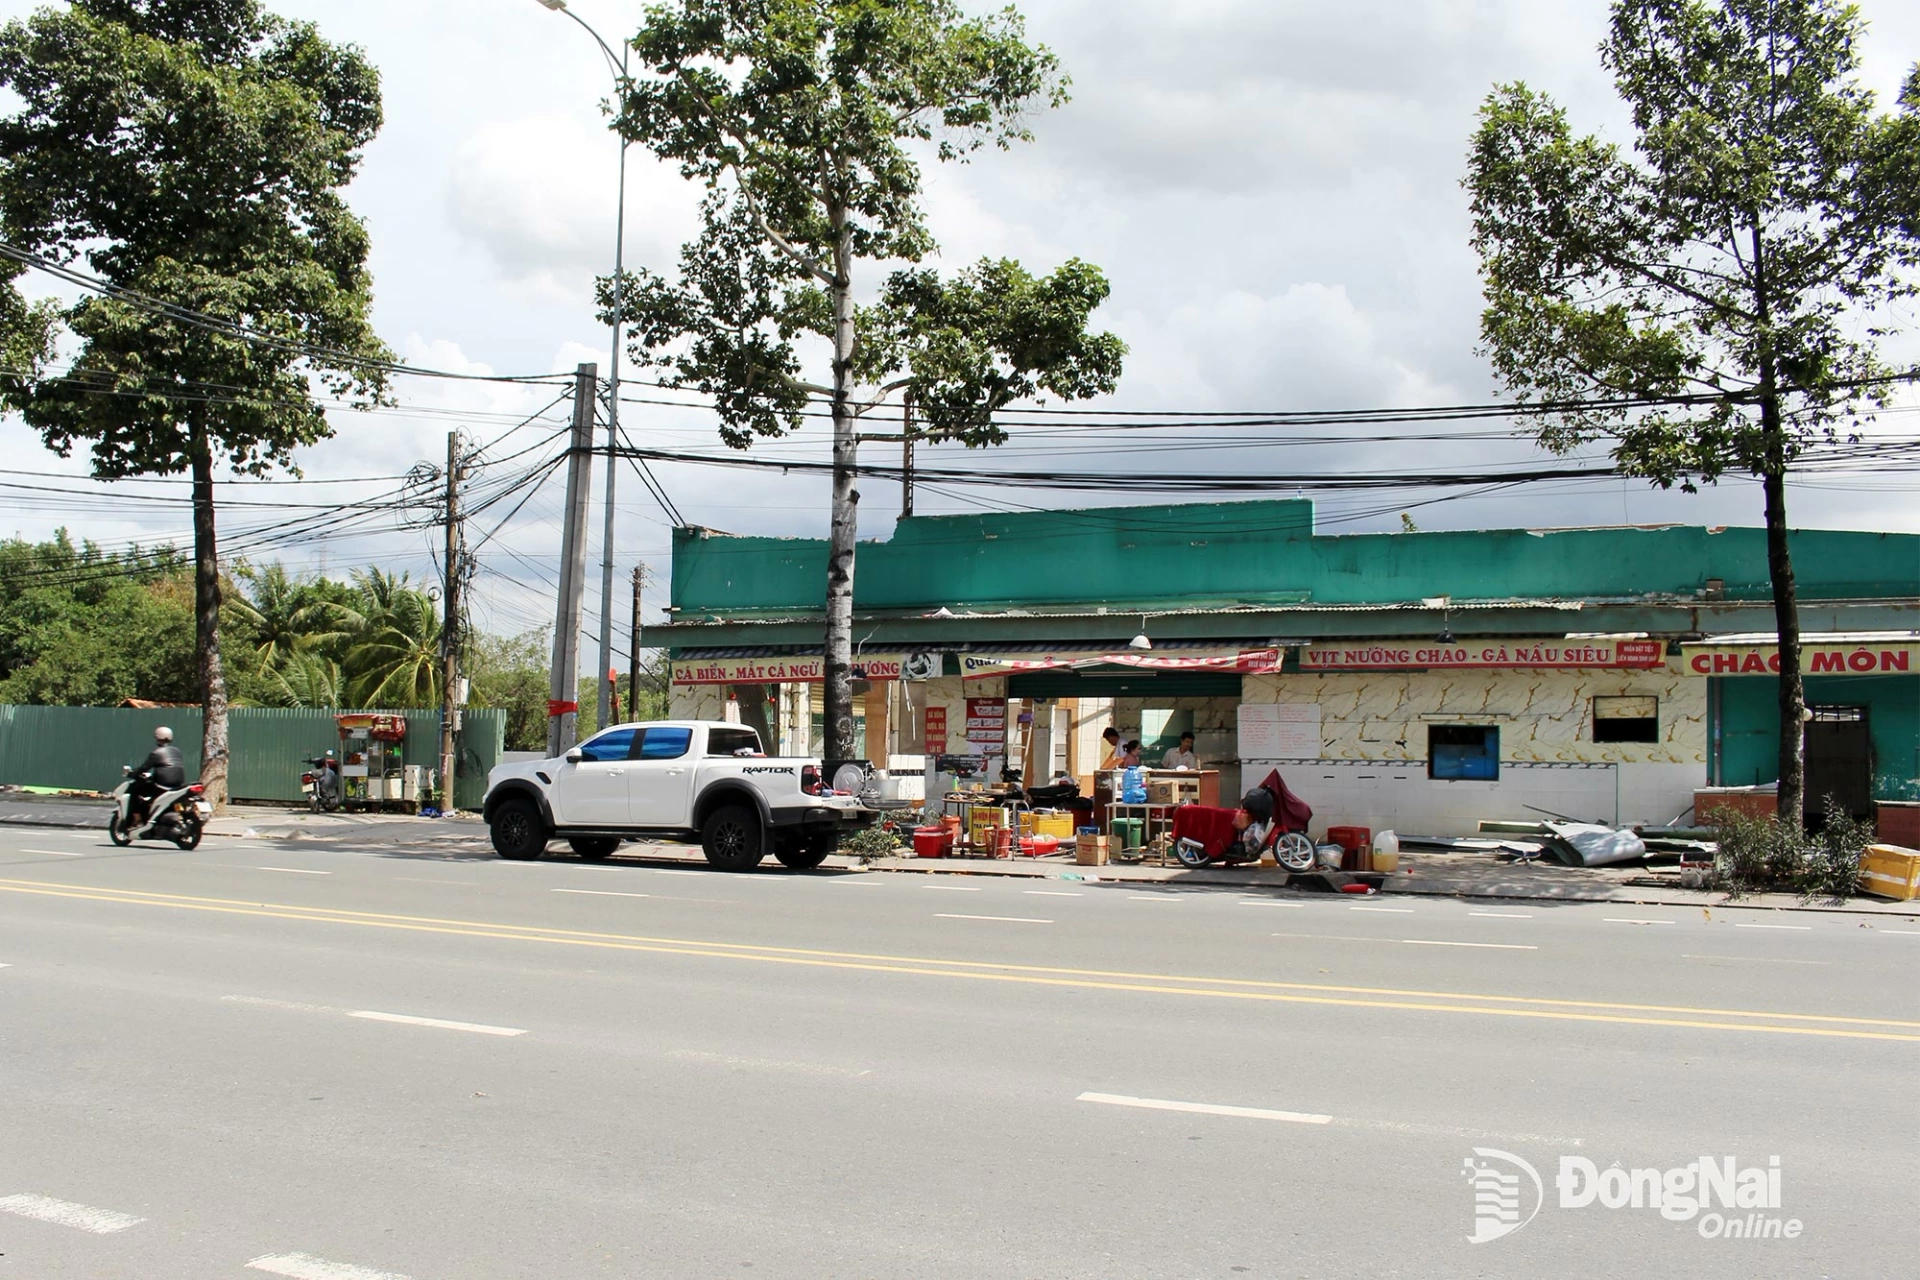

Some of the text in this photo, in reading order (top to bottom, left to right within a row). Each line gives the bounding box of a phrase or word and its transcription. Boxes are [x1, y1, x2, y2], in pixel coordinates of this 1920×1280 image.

[1308, 651, 1338, 667] VỊT
[1344, 647, 1410, 663] NƯỚNG
[1415, 649, 1467, 663] CHAO
[1481, 645, 1508, 662] GÀ
[1515, 642, 1558, 662] NẤU
[1563, 645, 1609, 662] SIÊU
[1810, 647, 1909, 672] MÔN
[675, 665, 693, 680] CÁ
[697, 662, 726, 680] BIỂN
[736, 660, 764, 678] MẮT
[768, 662, 786, 677] CÁ
[789, 661, 819, 677] NGỪ
[742, 766, 796, 777] RAPTOR
